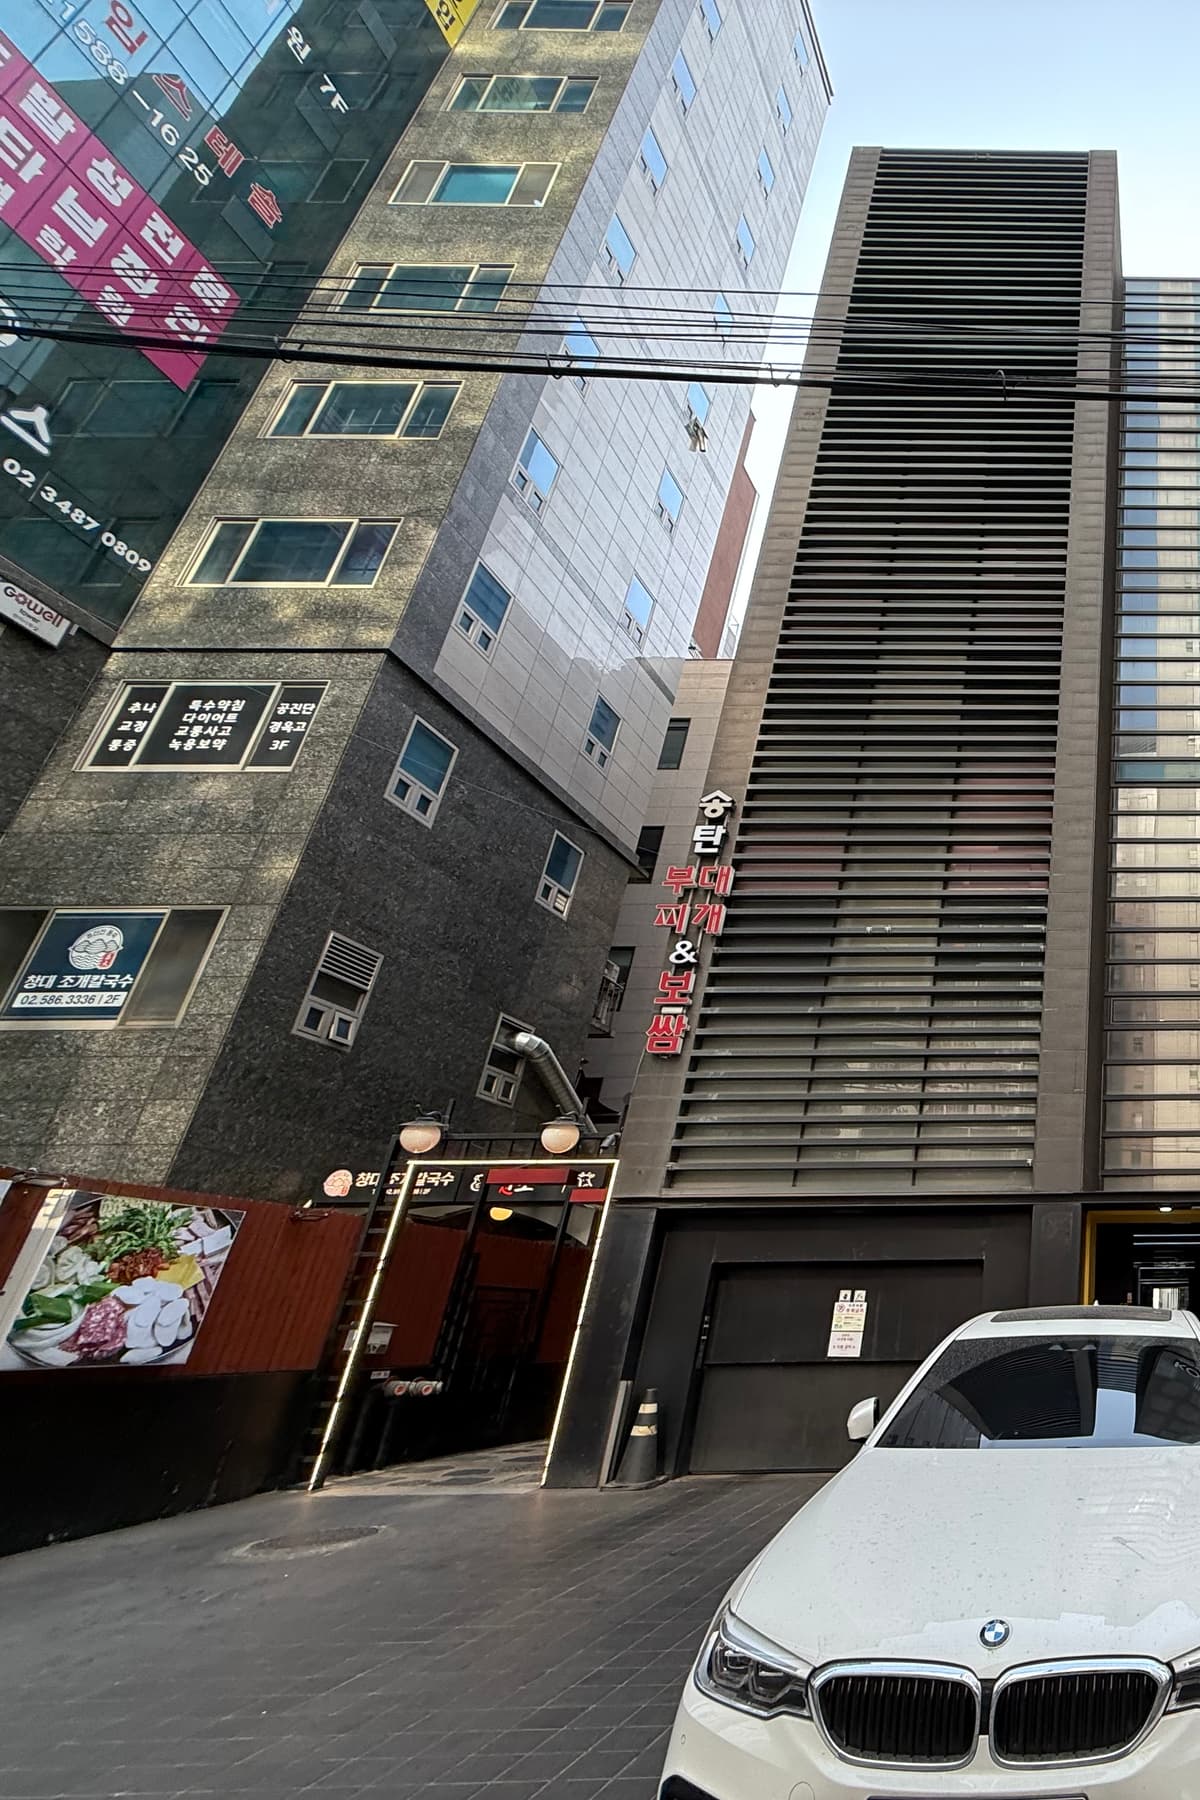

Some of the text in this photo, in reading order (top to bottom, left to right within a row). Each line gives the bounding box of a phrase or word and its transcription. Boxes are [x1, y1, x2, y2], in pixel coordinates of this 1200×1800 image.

[320, 73, 350, 114] 7F
[3, 457, 152, 574] 02 3487 0809
[4, 585, 65, 628] Gowell
[128, 702, 158, 714] 추나
[188, 699, 246, 712] 특수약침
[276, 702, 316, 716] 공진단
[181, 712, 239, 724] 다이어트
[117, 721, 148, 733] 교정
[174, 725, 232, 737] 교통사고
[268, 720, 307, 734] 경옥고
[108, 739, 137, 752] 통증
[168, 738, 227, 751] 녹용보약
[269, 739, 291, 751] 3F
[692, 789, 736, 854] 송탄
[662, 864, 735, 896] 부대
[654, 903, 726, 935] 찌개
[669, 940, 698, 964] &
[23, 973, 134, 990] 창대 조개칼국수
[20, 994, 121, 1006] 02.586.3336 2F
[646, 971, 695, 1054] 보쌈
